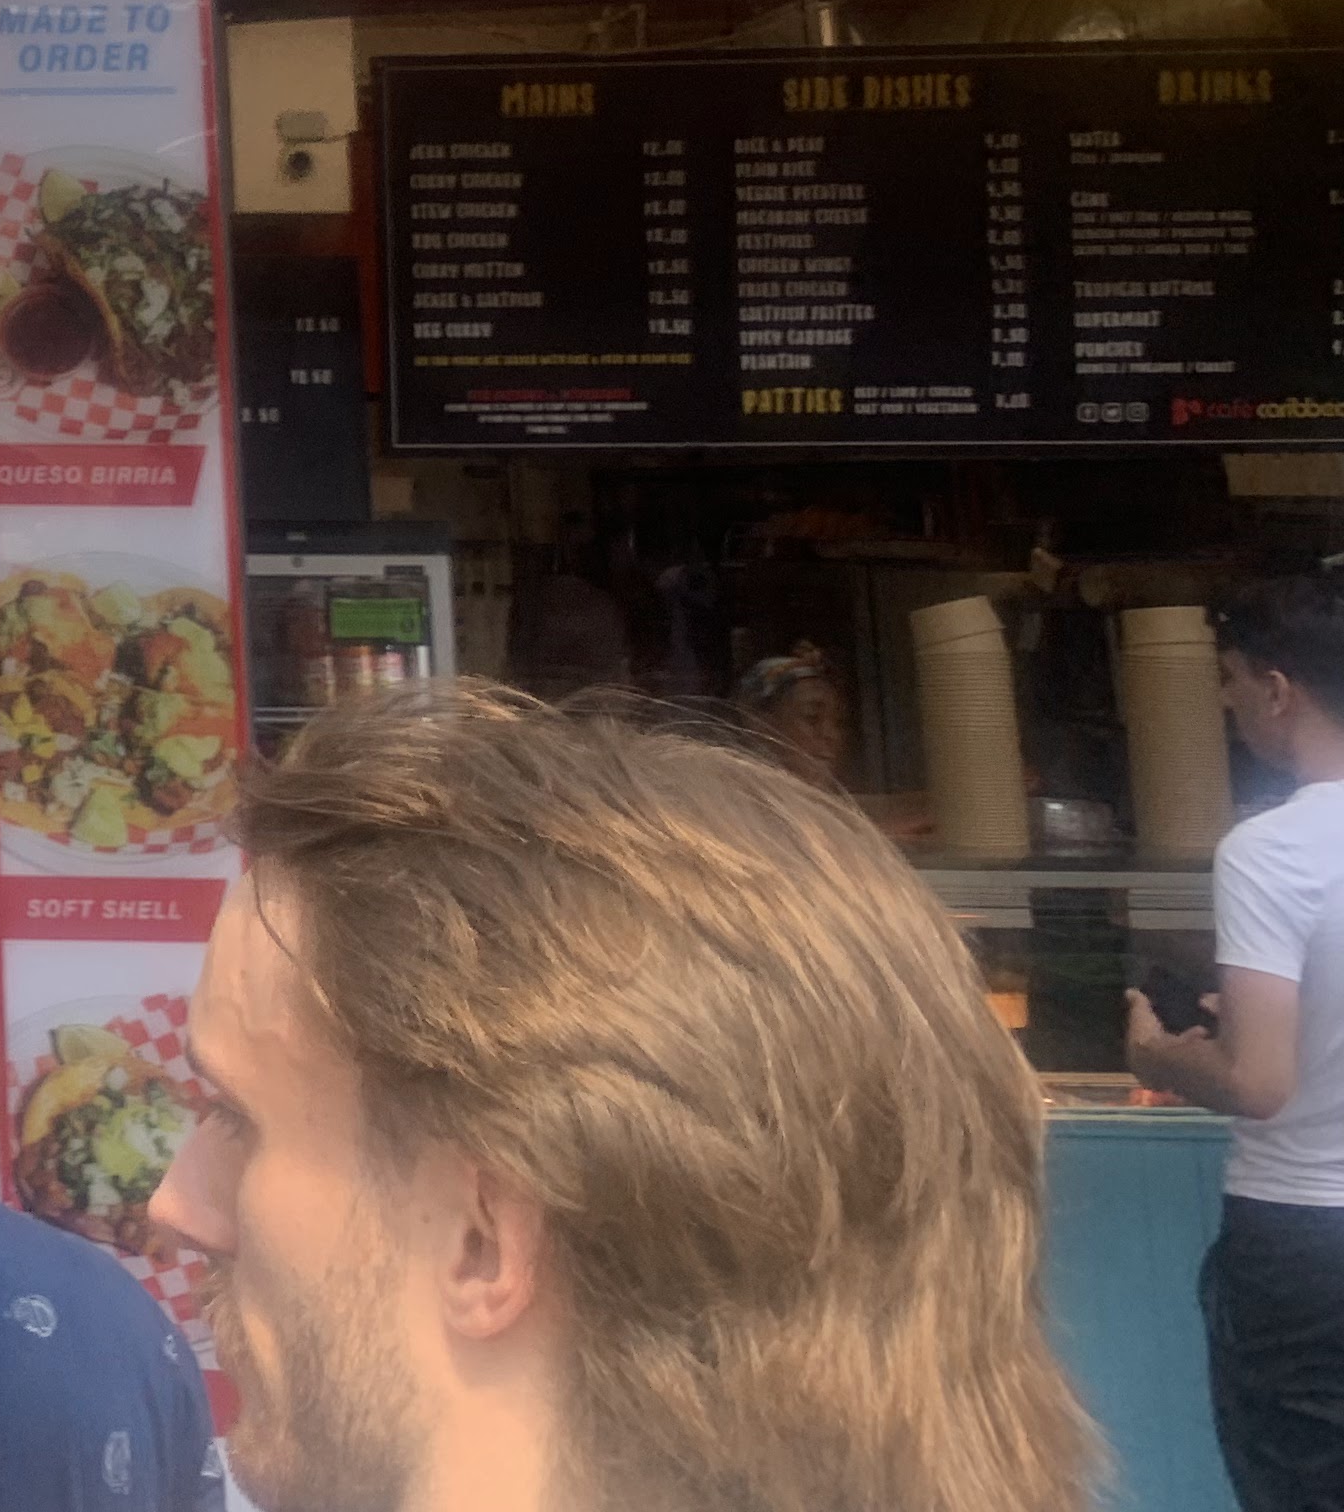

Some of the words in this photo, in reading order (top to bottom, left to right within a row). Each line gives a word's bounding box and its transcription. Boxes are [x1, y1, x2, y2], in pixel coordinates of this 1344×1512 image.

[126, 3, 171, 34] TO
[18, 42, 152, 74] ORDER
[500, 83, 595, 118] MAINS
[783, 75, 848, 111] SIDE
[862, 72, 972, 109] DISHES
[741, 388, 843, 415] PATTIES
[90, 466, 176, 485] BIRRIA
[26, 899, 95, 920] SOFT
[101, 899, 183, 920] SHELL
